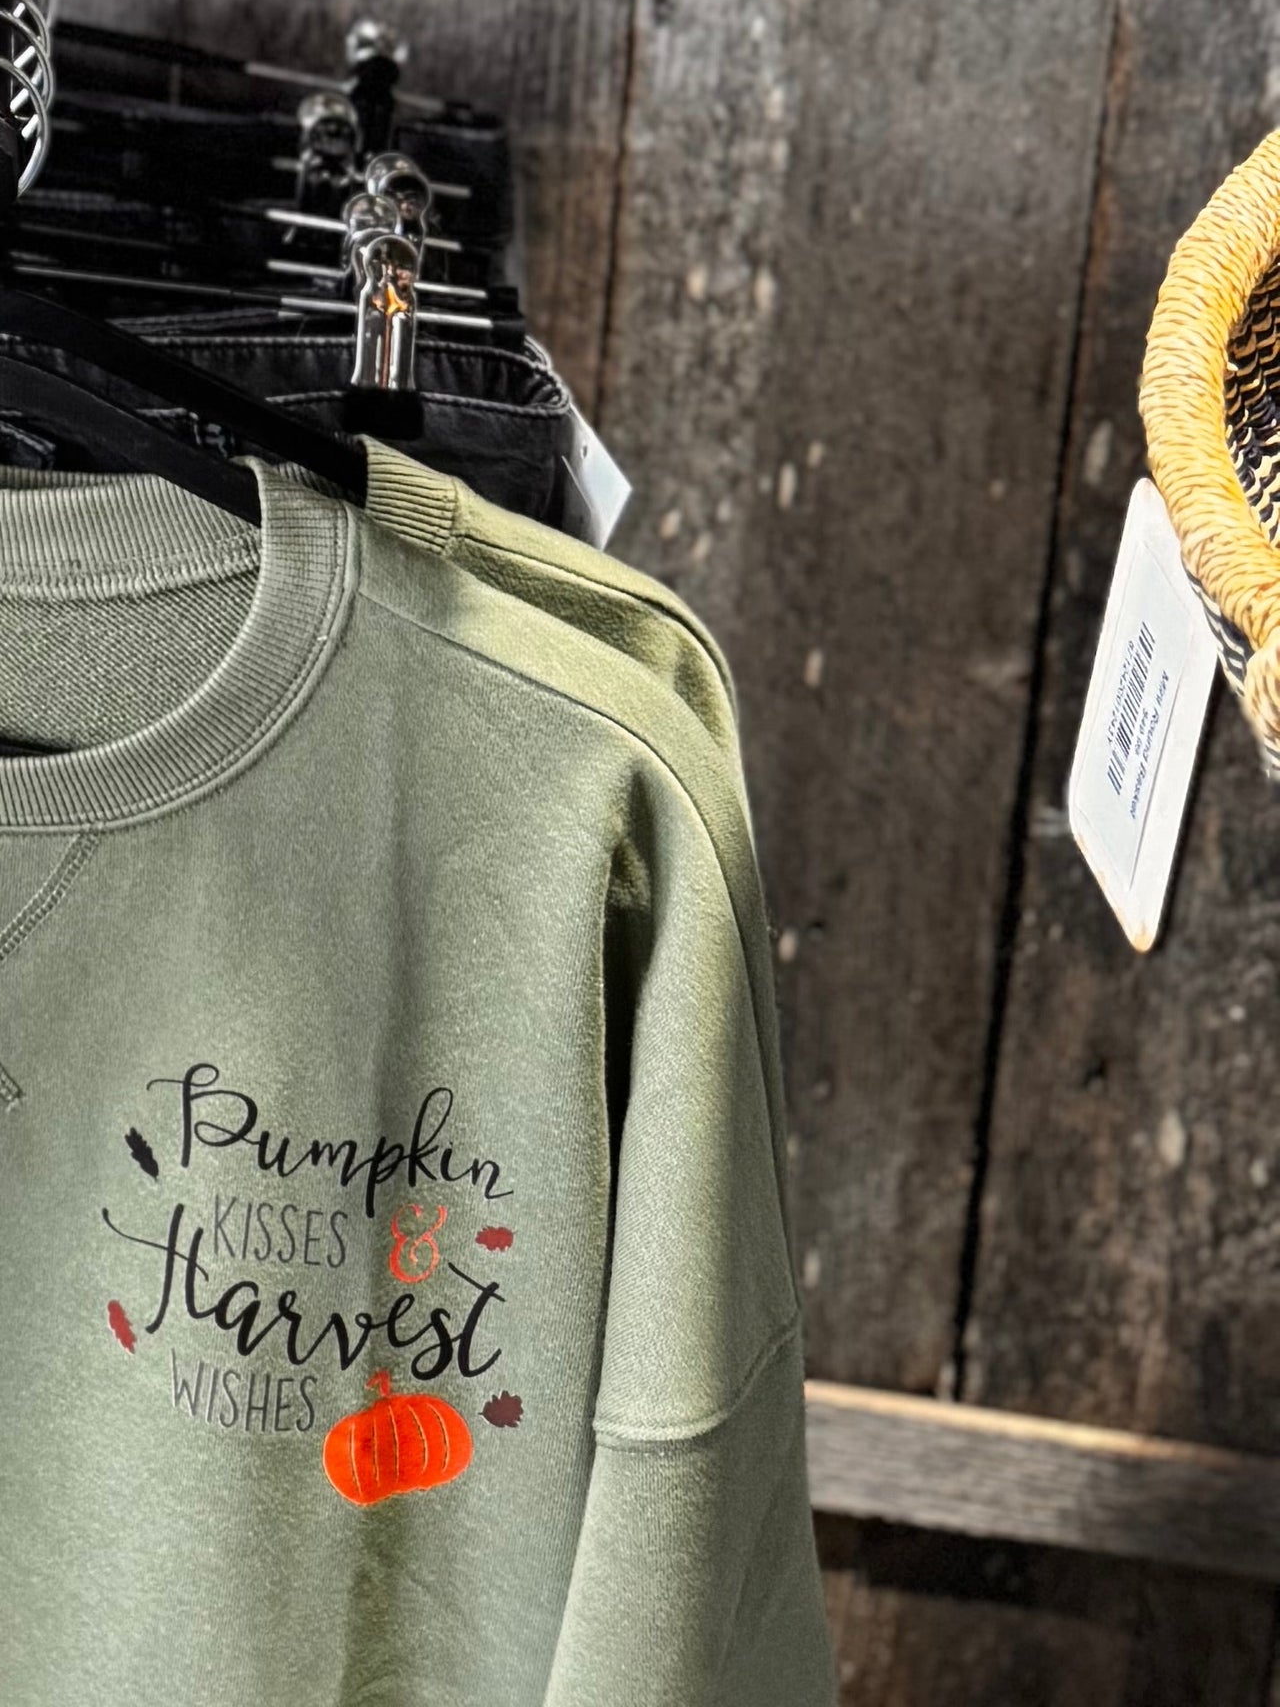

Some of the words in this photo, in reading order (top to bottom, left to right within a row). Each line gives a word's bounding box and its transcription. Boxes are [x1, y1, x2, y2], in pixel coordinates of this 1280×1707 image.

[146, 1062, 515, 1218] Pumpkin
[101, 1202, 506, 1381] Harvest
[213, 1194, 348, 1268] KISSES
[388, 1202, 448, 1284] &
[170, 1347, 318, 1433] WISHES
